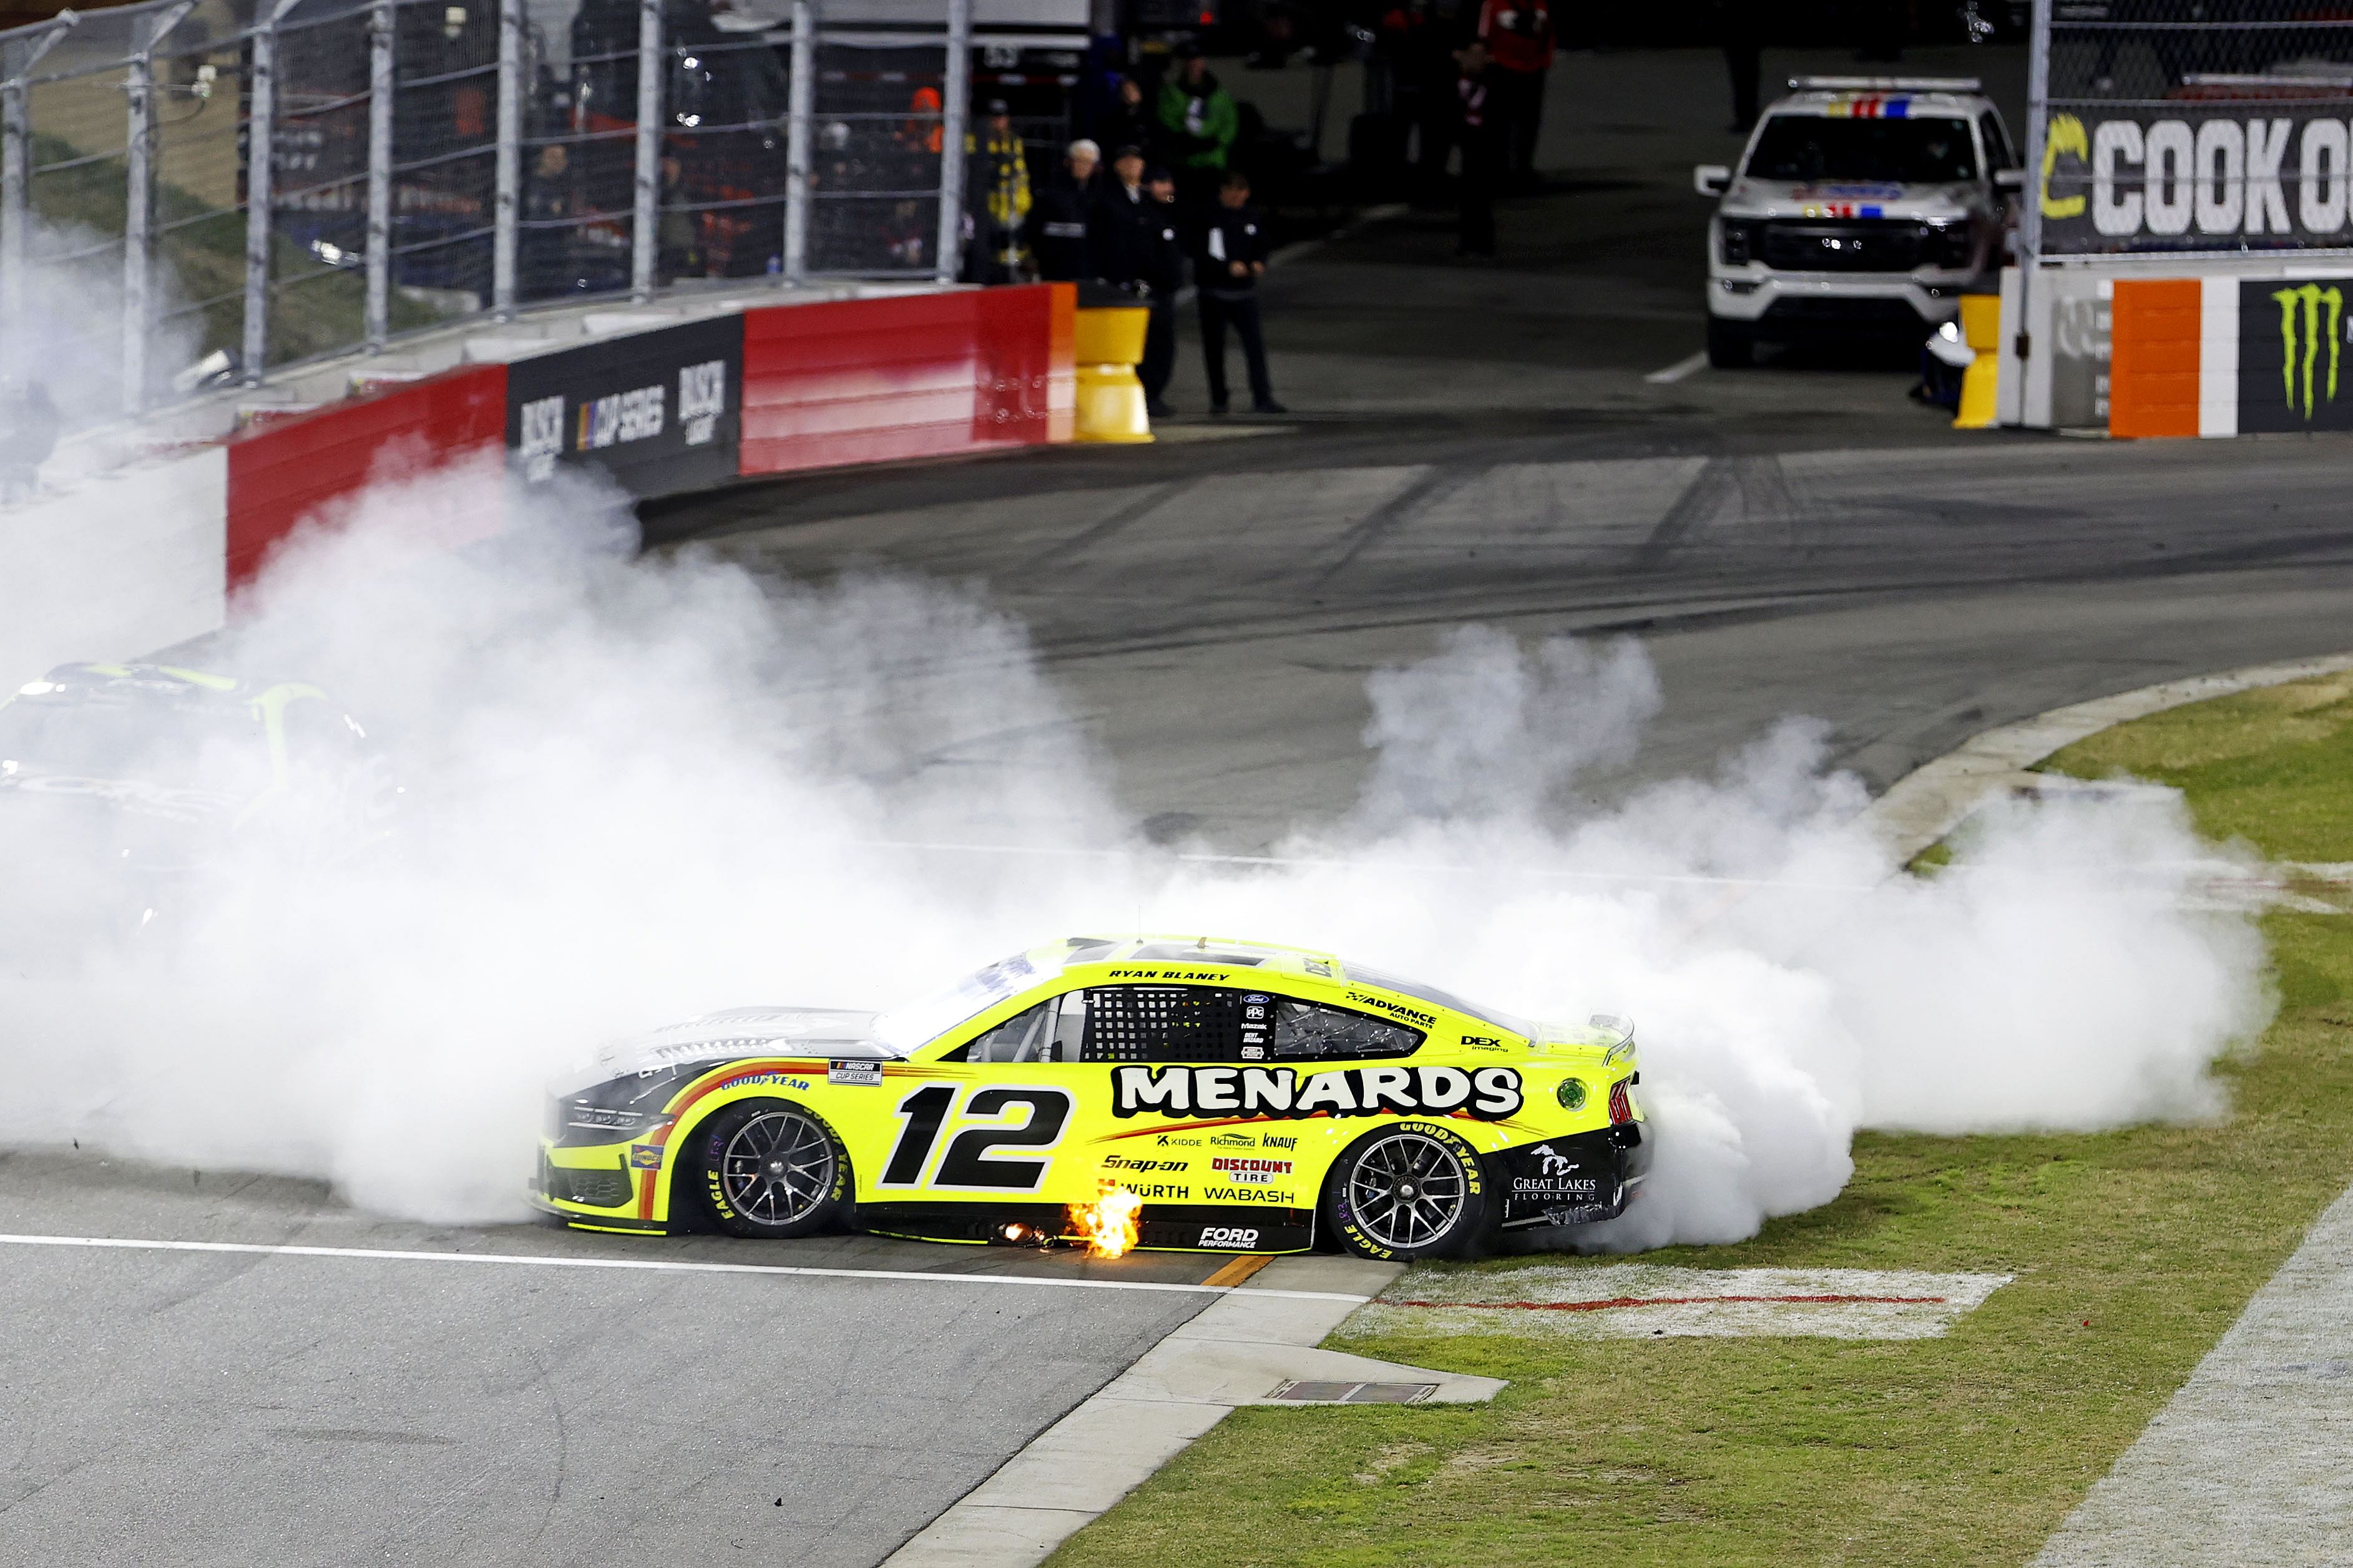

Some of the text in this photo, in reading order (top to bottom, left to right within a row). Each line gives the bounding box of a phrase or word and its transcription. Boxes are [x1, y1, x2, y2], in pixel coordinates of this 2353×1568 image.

[2092, 117, 2353, 235] COOK O
[1162, 971, 1230, 981] BLANEY
[1248, 1007, 1263, 1018] PPG
[1362, 997, 1437, 1025] ADVANCE
[1389, 1012, 1433, 1029] AUTO PARTS
[1460, 1035, 1502, 1048] DEX
[844, 1062, 874, 1071] NASCAR
[852, 1073, 874, 1081] SERIES
[1115, 1066, 1522, 1118] MENARDS
[878, 1084, 1074, 1191] 12
[1171, 1138, 1202, 1147] KIDDE
[1210, 1134, 1256, 1147] Richmond
[1101, 1154, 1189, 1173] Snap-on
[1211, 1157, 1293, 1174] DISCOUNT
[1233, 1173, 1269, 1183] TIRE
[1513, 1177, 1597, 1191] GREAT LAKES
[707, 1169, 736, 1220] EAGLE
[1204, 1187, 1295, 1204] WABASH
[1514, 1193, 1595, 1202] FLOORING
[1200, 1227, 1260, 1242] FORD
[1198, 1240, 1256, 1249] PERFORMANCE
[1343, 1224, 1394, 1260] EAGLE
